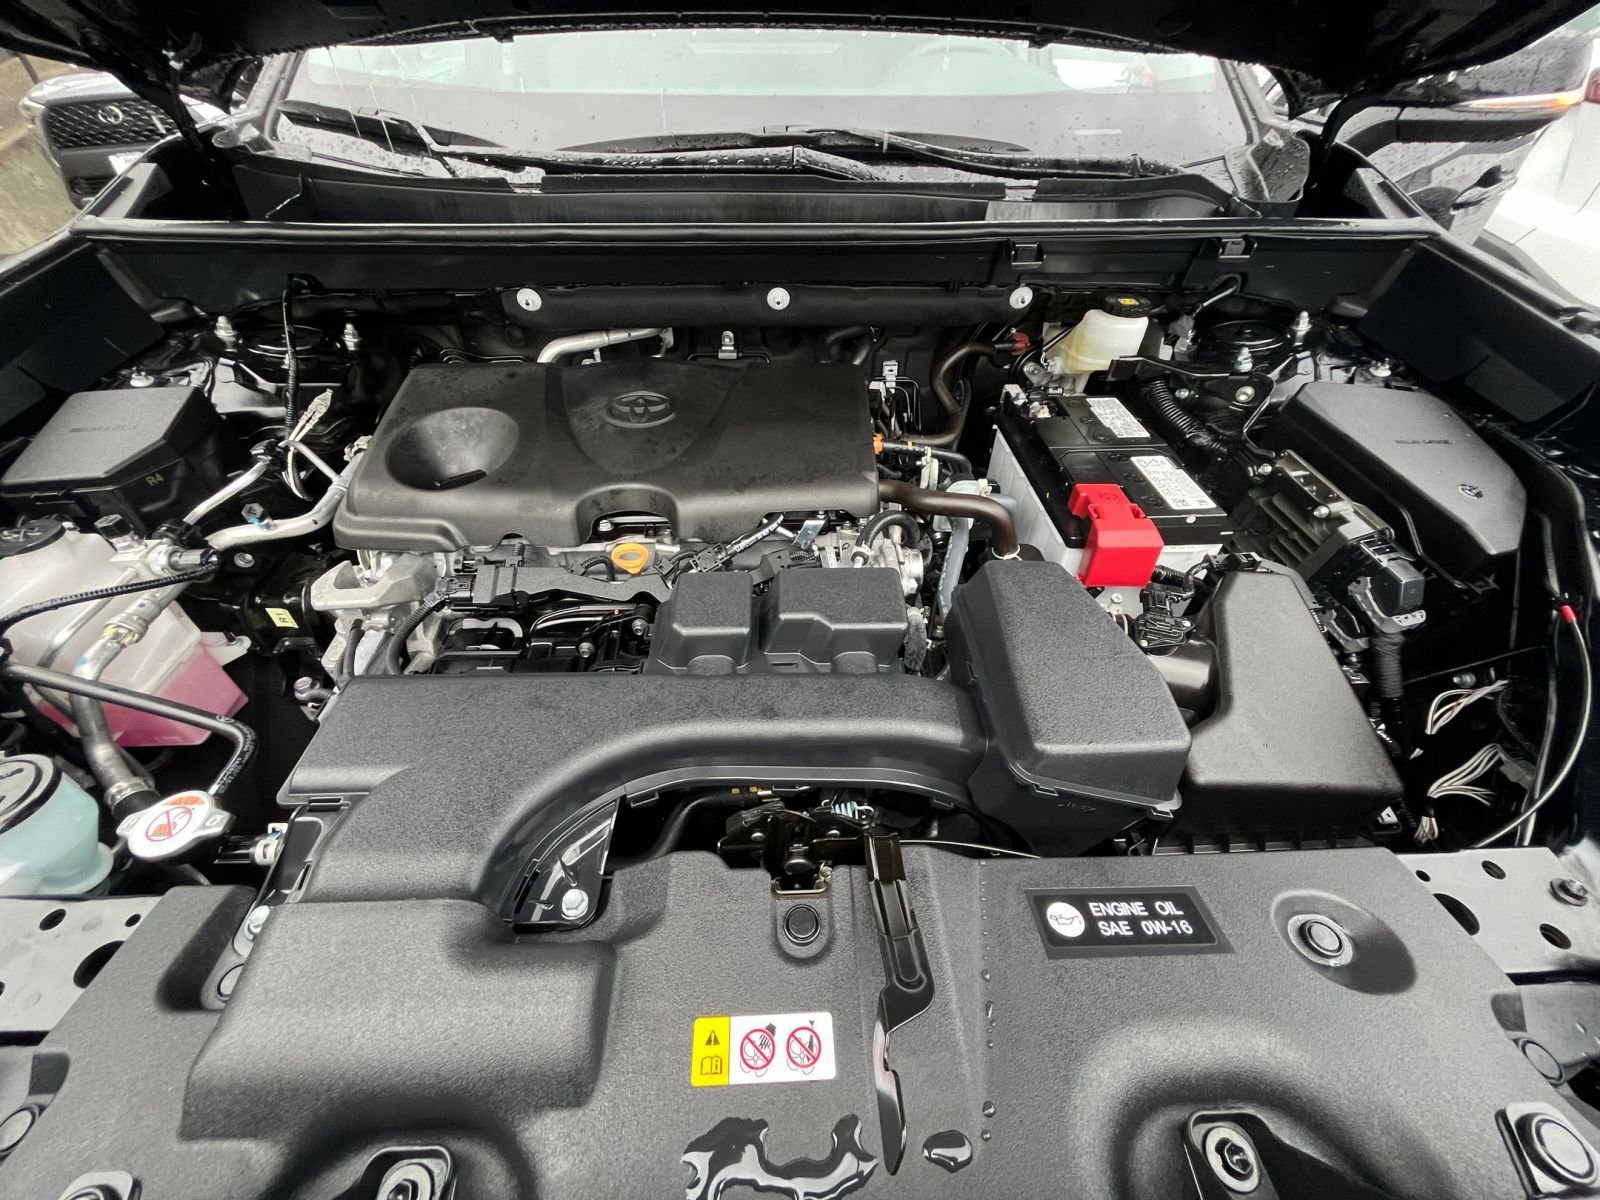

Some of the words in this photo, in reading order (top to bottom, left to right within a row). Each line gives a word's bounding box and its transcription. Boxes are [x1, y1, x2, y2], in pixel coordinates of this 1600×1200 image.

[145, 472, 165, 487] R4
[1088, 901, 1149, 916] ENGINE
[1154, 901, 1184, 915] OIL
[1098, 920, 1134, 936] SAE
[1141, 919, 1194, 935] 0W-16
